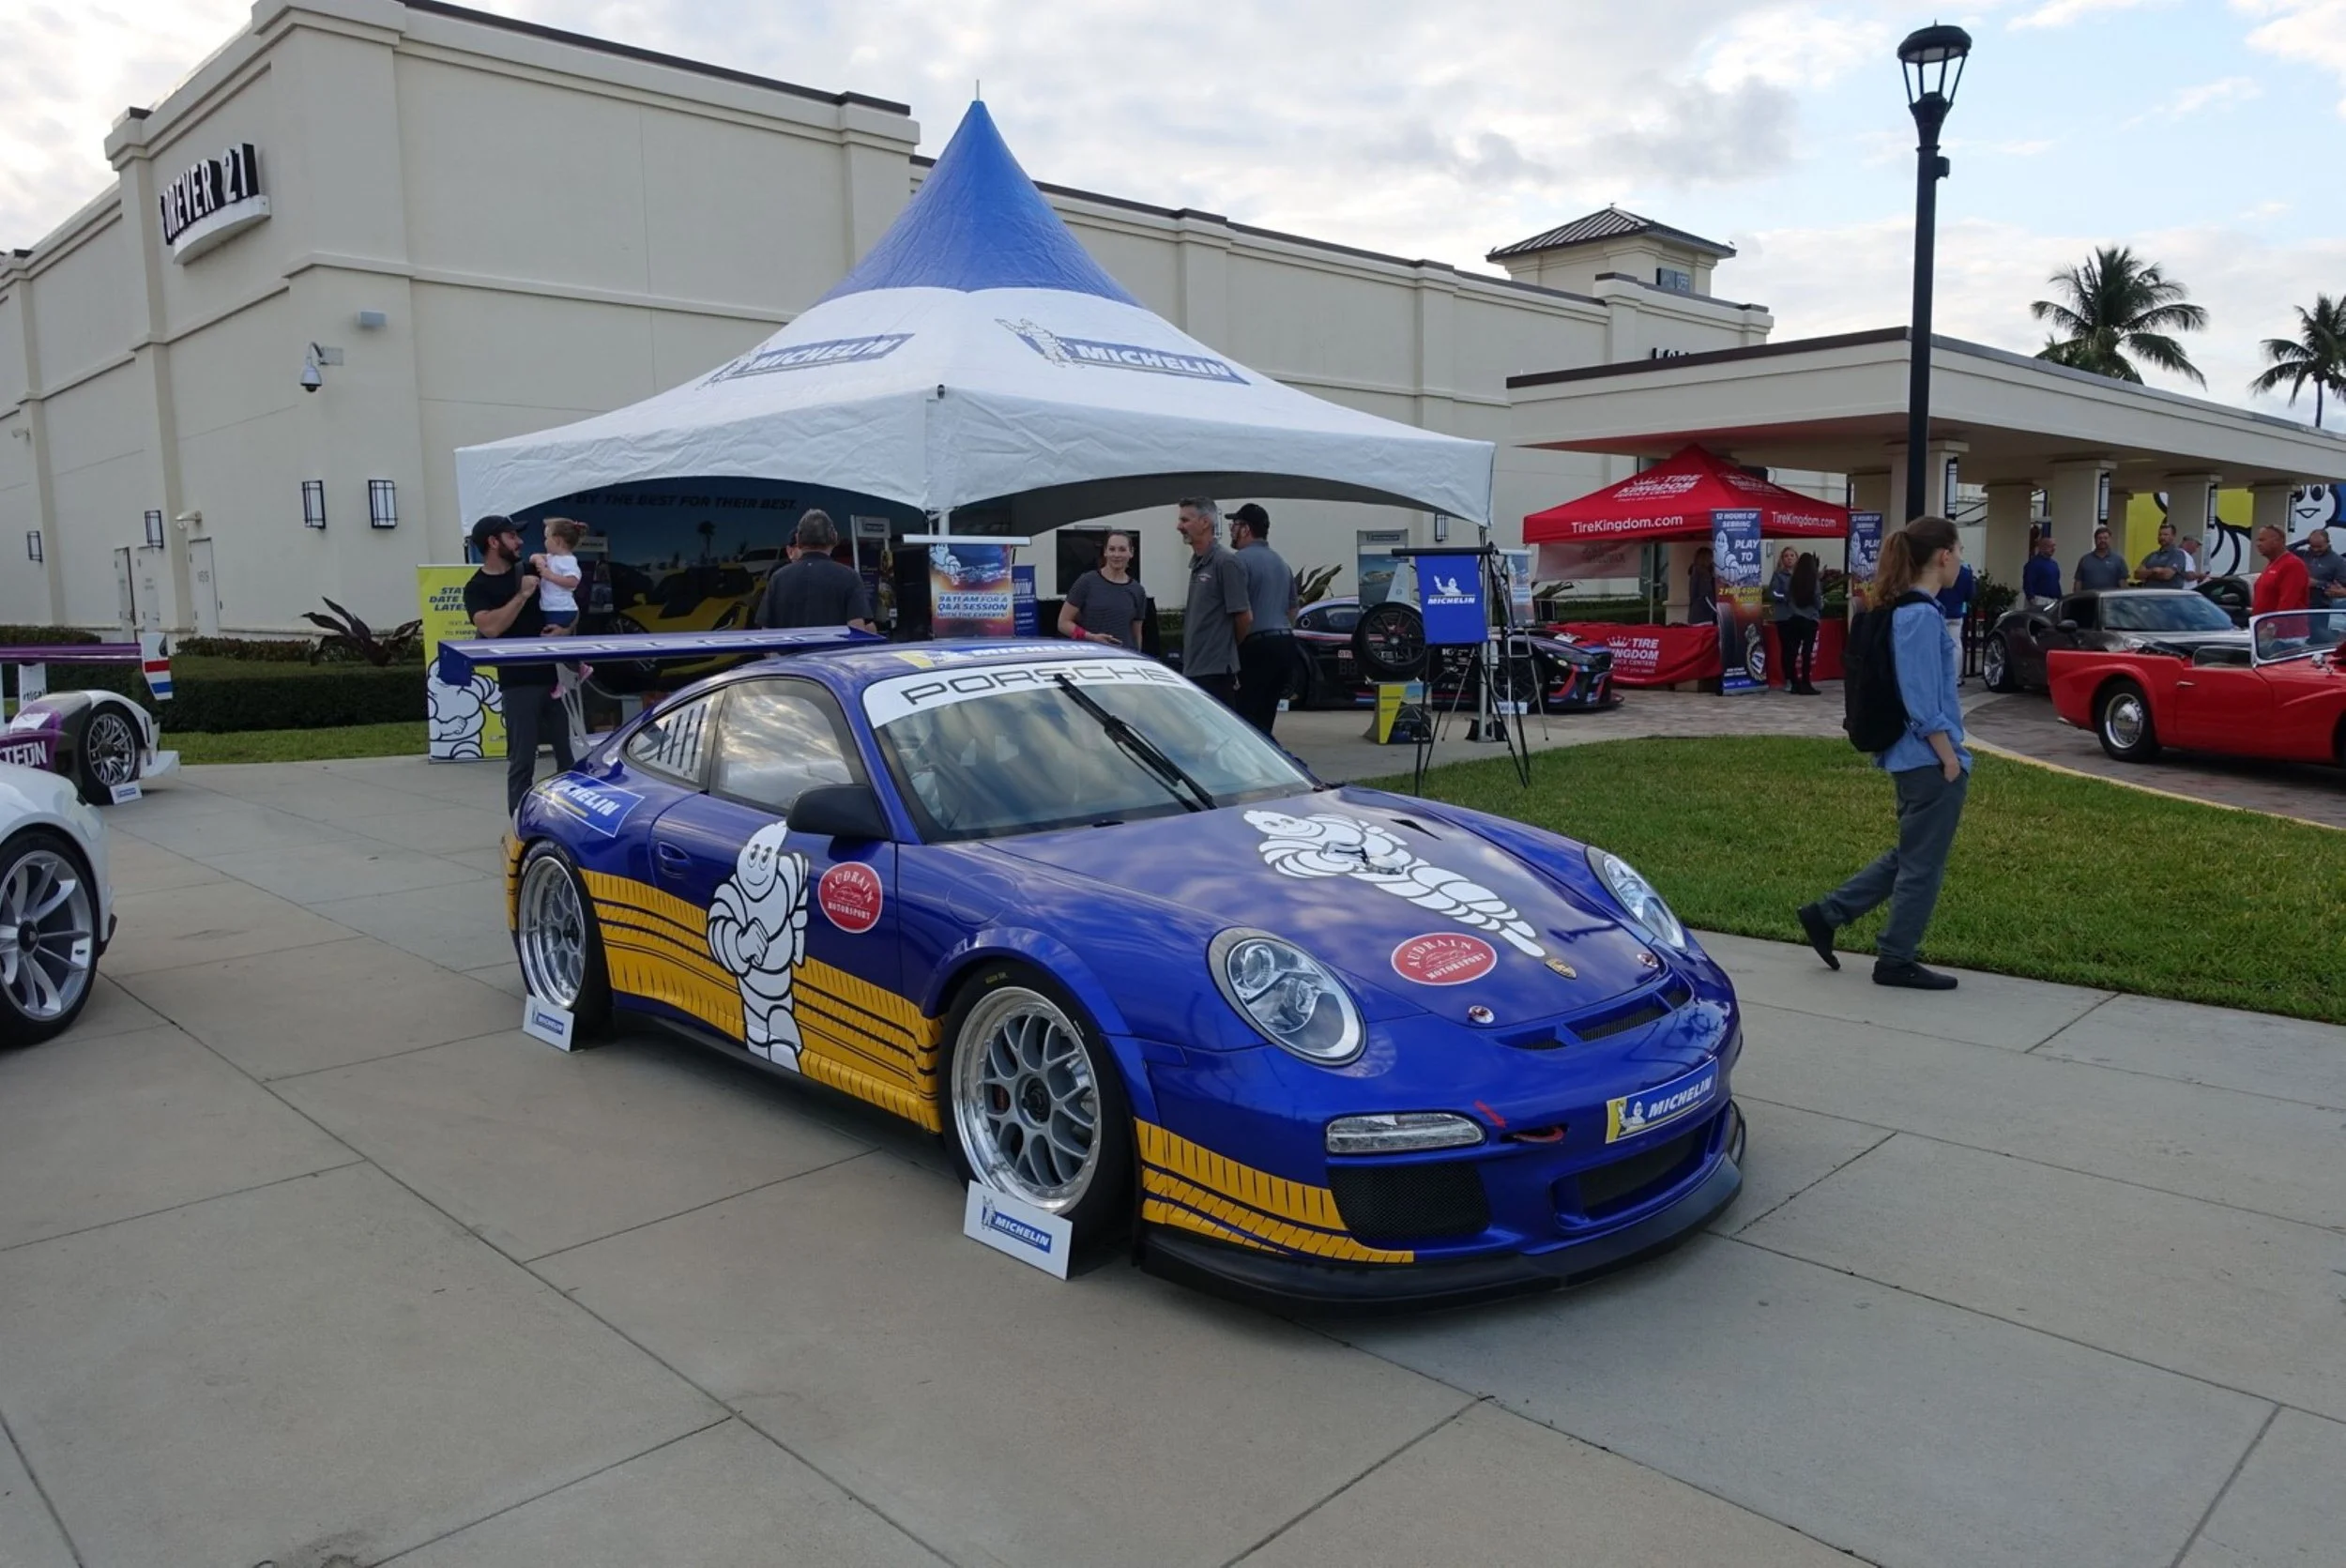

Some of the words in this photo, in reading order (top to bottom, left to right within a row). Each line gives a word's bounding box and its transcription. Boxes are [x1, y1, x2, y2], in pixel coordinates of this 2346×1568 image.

[160, 159, 222, 245] OREVER
[222, 143, 259, 203] 21
[746, 337, 902, 372] MICHELIN
[1074, 344, 1231, 376] MICHELIN
[1666, 474, 1703, 482] TIRE
[1571, 515, 1683, 533] TireKingdom.com
[1771, 511, 1836, 527] TireKingdom.com
[1734, 539, 1760, 549] PLAY
[1742, 552, 1754, 561] TO
[1738, 564, 1760, 573] WIN
[429, 595, 458, 604] DATE
[963, 602, 1008, 611] SESSION
[1427, 597, 1476, 605] MICHELIN
[972, 645, 1099, 657] MICHELIN
[1631, 637, 1660, 649] TIRE
[901, 665, 1180, 706] PORSCHE
[829, 870, 874, 903] AUDRAIN
[827, 901, 871, 920] MOTORSPORT
[1408, 939, 1471, 968] AUDRAIN
[1425, 952, 1487, 980] MOTORSPORT
[1647, 1075, 1713, 1119] MICHELIN
[995, 1216, 1050, 1246] MICHELIN
